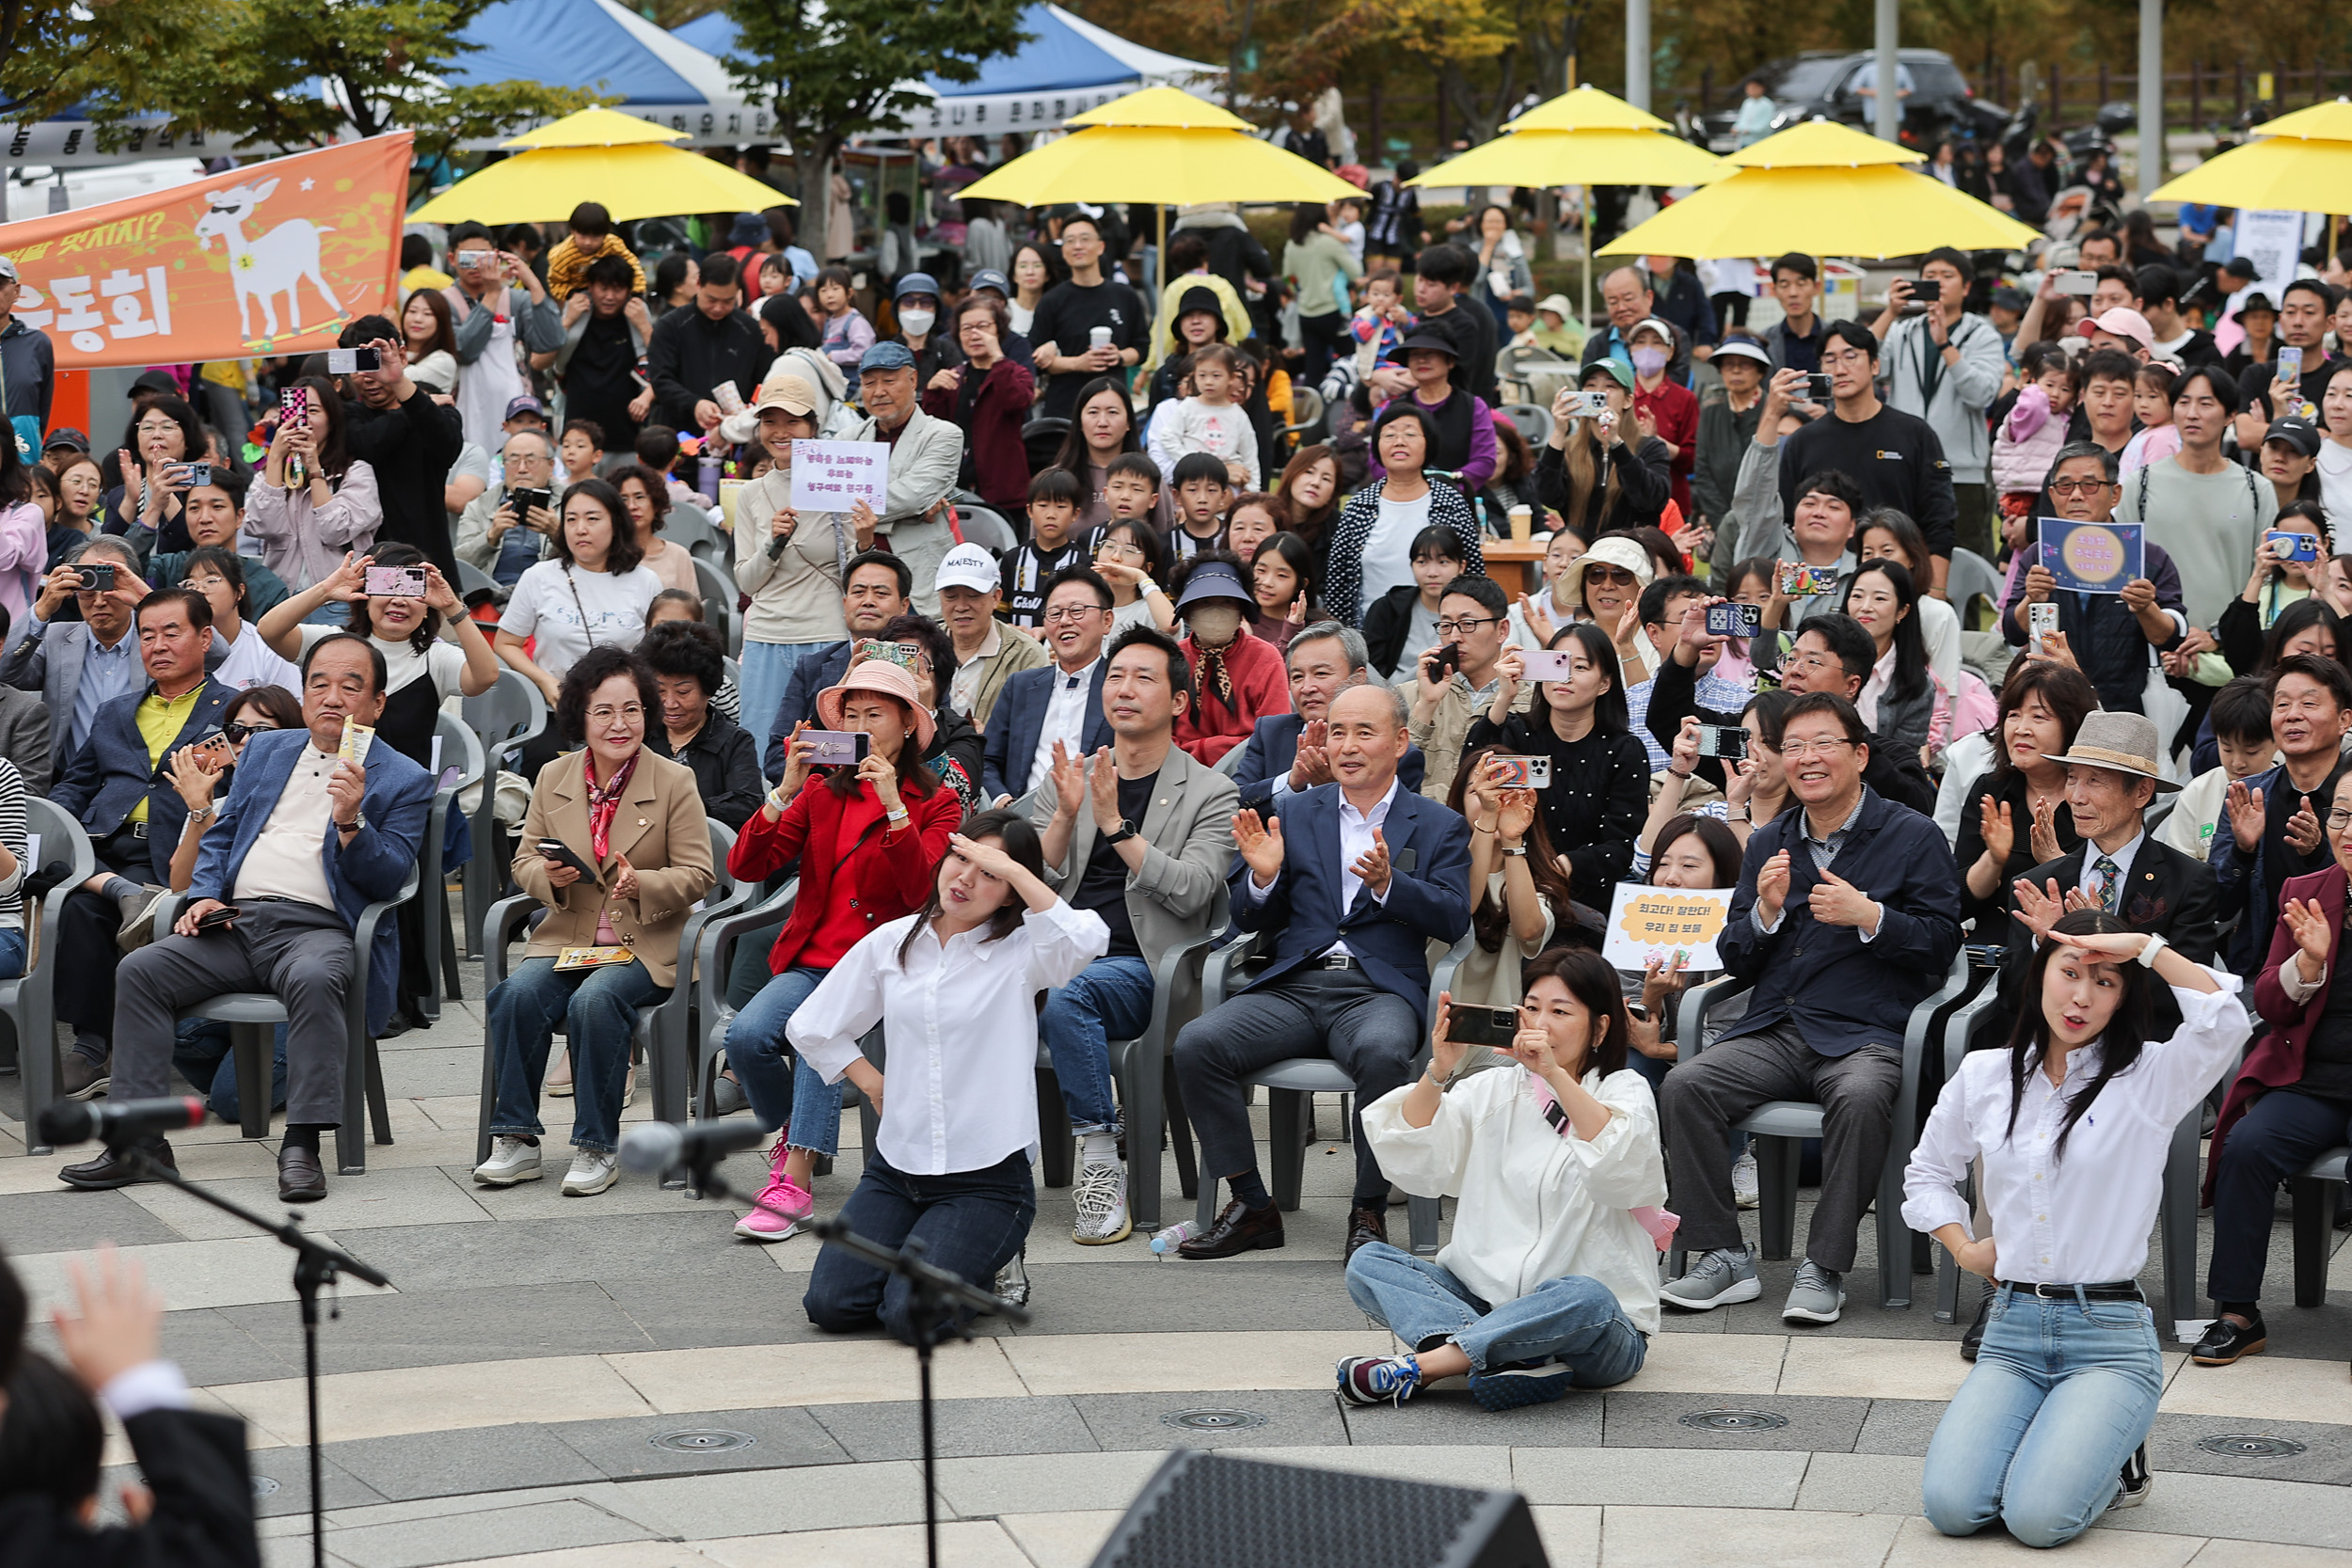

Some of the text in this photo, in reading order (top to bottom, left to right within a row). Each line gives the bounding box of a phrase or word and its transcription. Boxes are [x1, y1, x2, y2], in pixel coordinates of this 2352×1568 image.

[56, 211, 167, 256] 멋지지?
[836, 454, 874, 466] 노래하는
[827, 468, 854, 479] 우리는
[846, 483, 874, 494] 친구들
[946, 557, 984, 568] MAJESTY
[1639, 902, 1712, 916] 최고다! 잘한다!
[1645, 922, 1703, 934] 우리 집 보물
